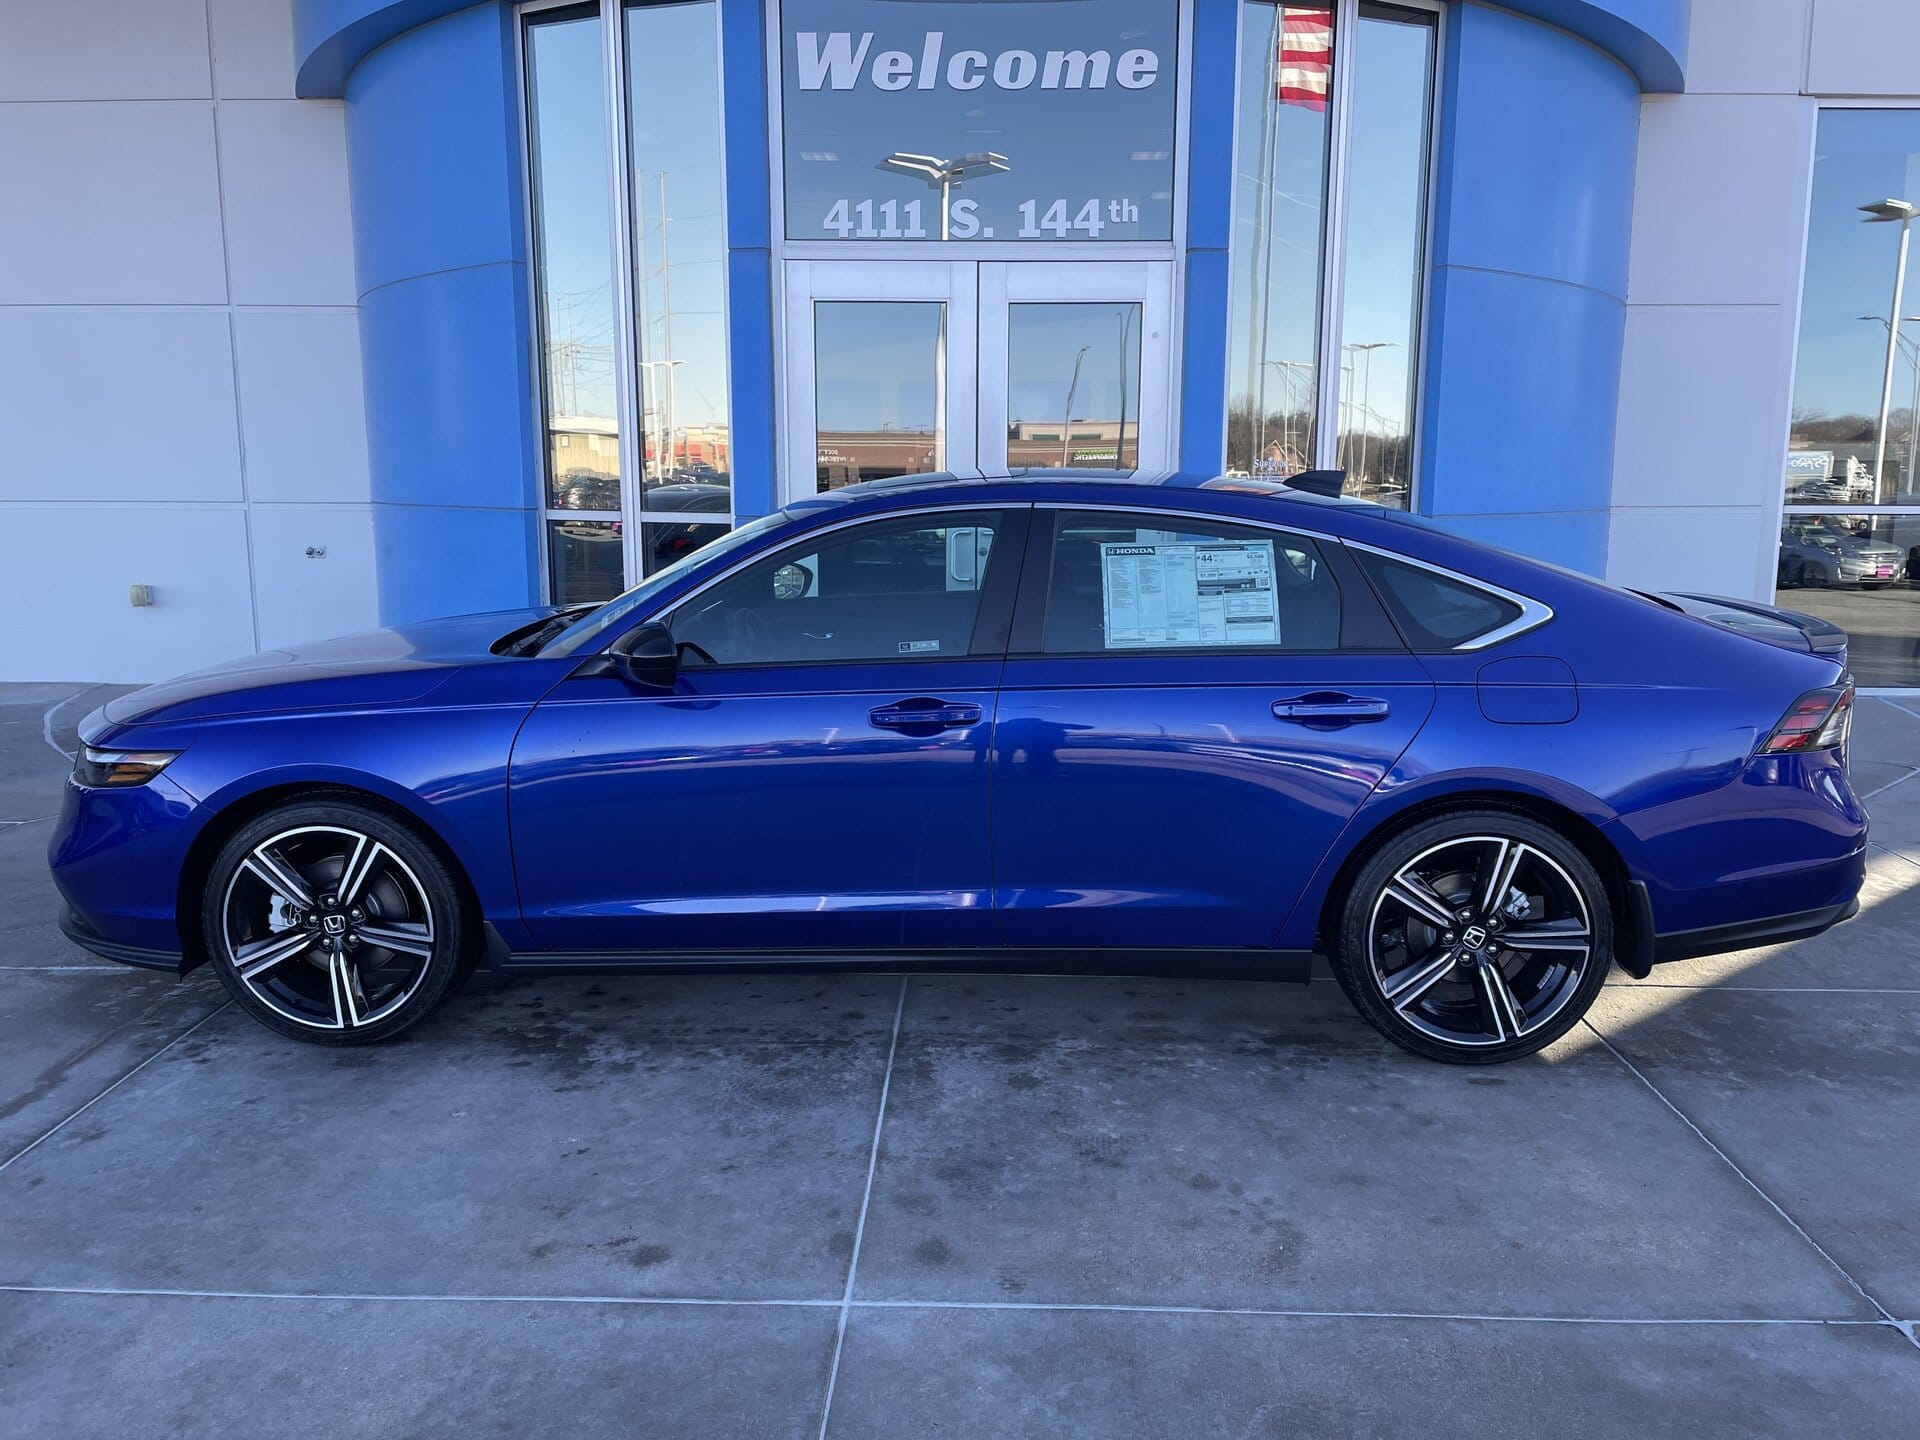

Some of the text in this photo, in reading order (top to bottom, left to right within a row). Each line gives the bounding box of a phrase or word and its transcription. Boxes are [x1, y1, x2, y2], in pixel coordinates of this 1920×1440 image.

[796, 31, 1159, 91] Welcome
[823, 198, 1138, 238] 4111 S. 144th
[1201, 554, 1213, 562] 44
